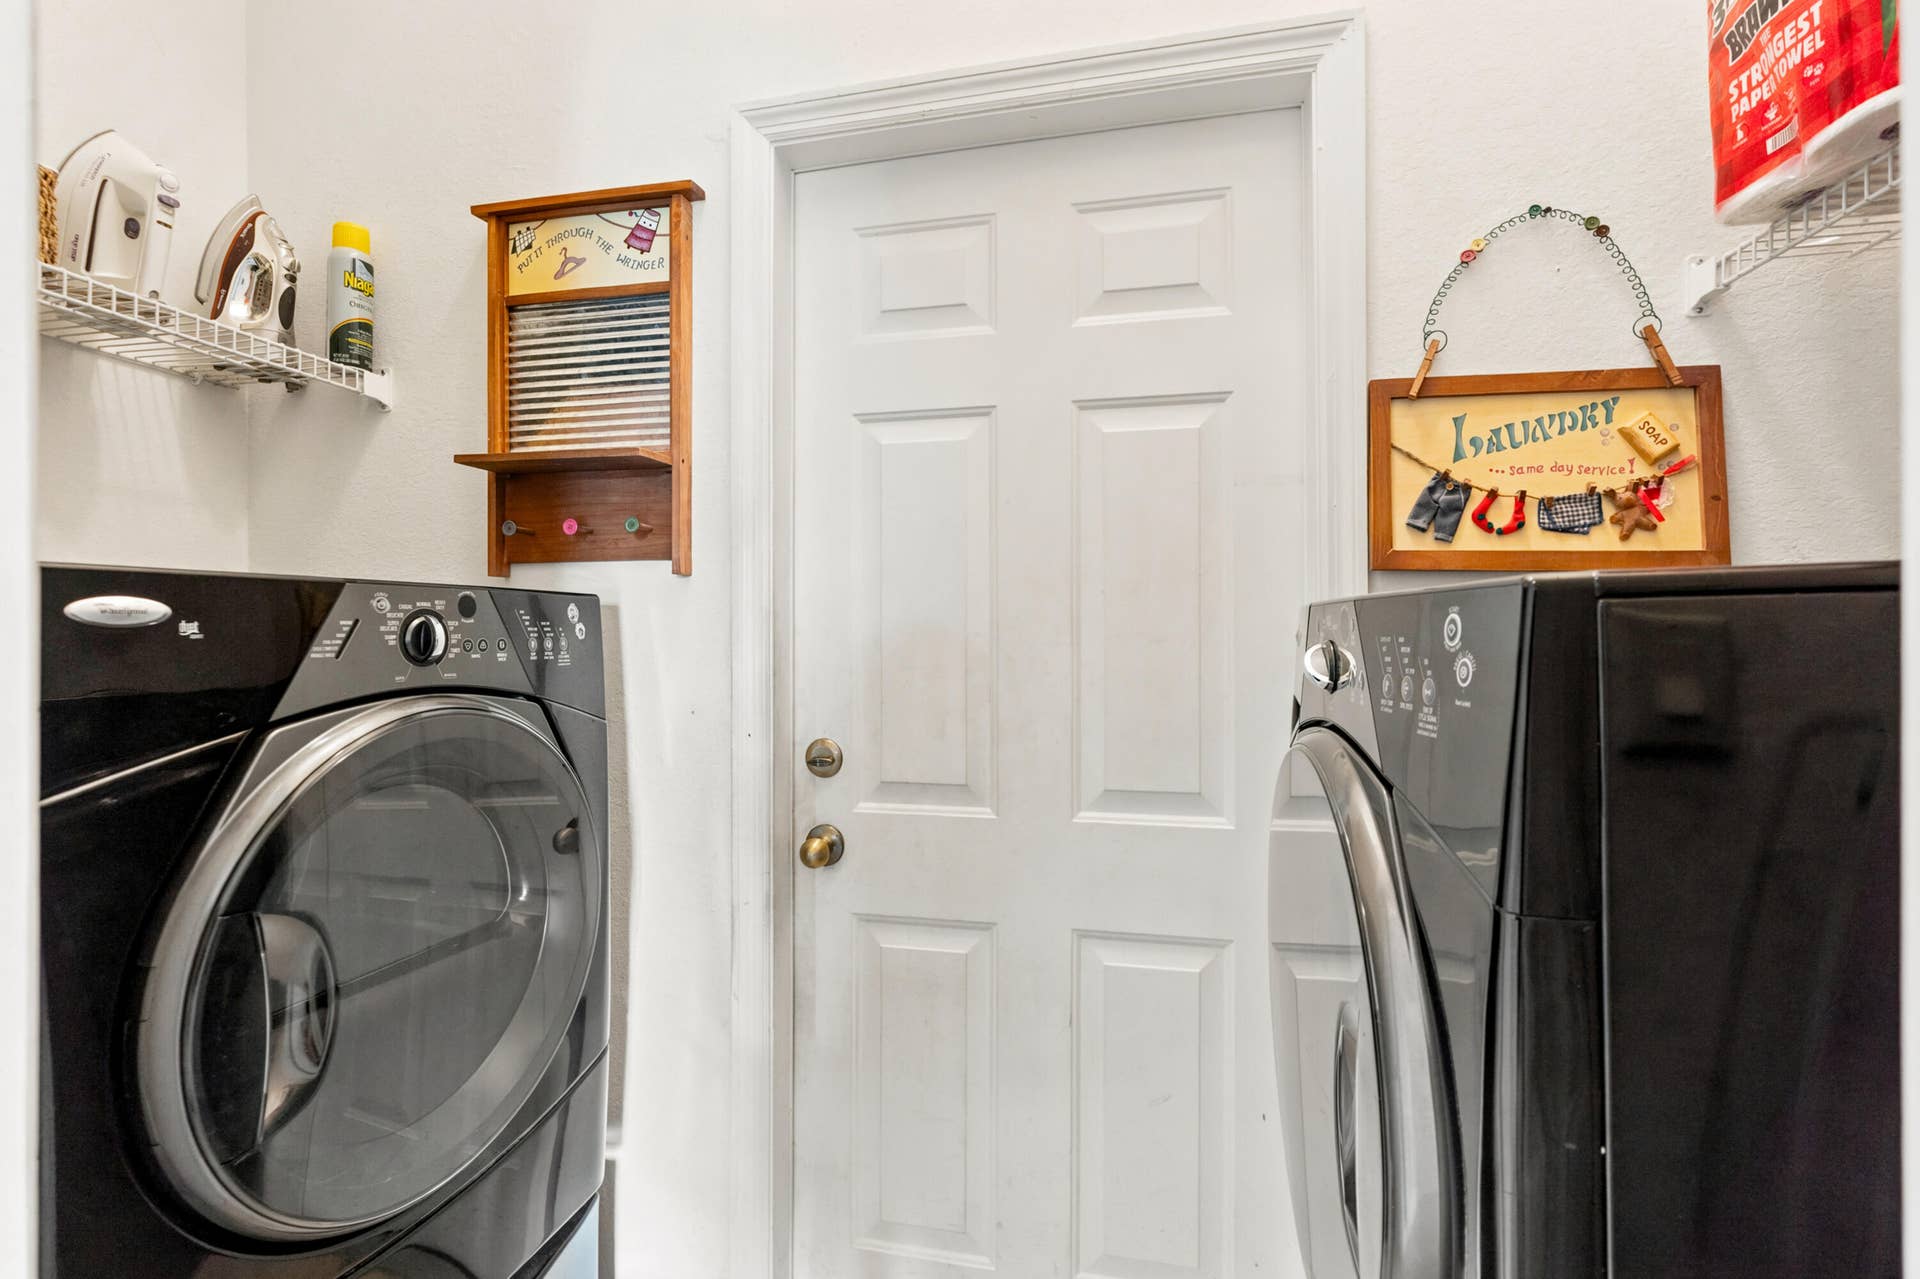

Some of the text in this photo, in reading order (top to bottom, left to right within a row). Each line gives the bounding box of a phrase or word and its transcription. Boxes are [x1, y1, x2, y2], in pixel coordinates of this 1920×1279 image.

[1728, 0, 1823, 104] STRONGEST
[1730, 29, 1826, 124] PAPER TOWEL
[517, 226, 665, 274] PUT IT THROUGH THE WRINGER
[1451, 395, 1621, 465] LAUNDRY
[1638, 420, 1669, 446] SOAP
[1550, 460, 1574, 477] day
[1576, 456, 1636, 477] service!
